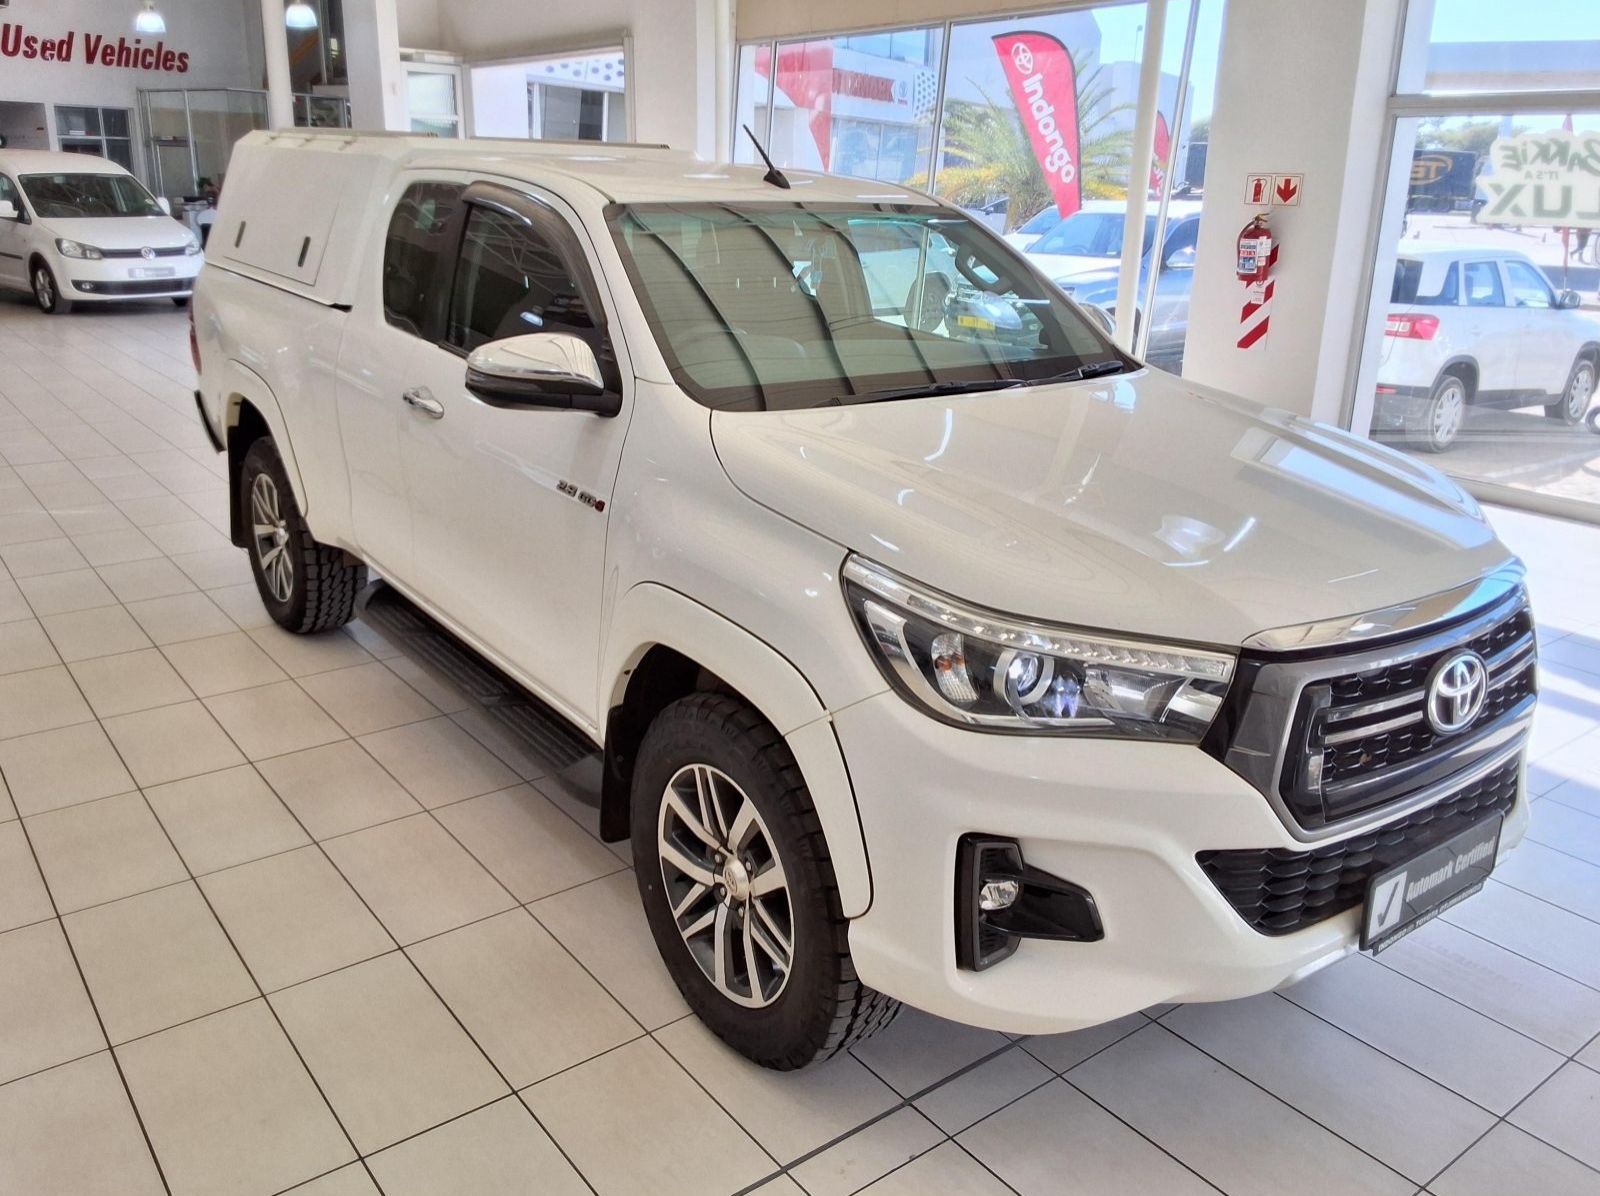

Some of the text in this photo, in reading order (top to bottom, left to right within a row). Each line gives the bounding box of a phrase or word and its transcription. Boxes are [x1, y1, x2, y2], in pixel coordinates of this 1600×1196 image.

[1, 23, 190, 73] Used Vehicles
[1022, 73, 1075, 183] Indongo
[1406, 836, 1496, 902] Automark Certified
